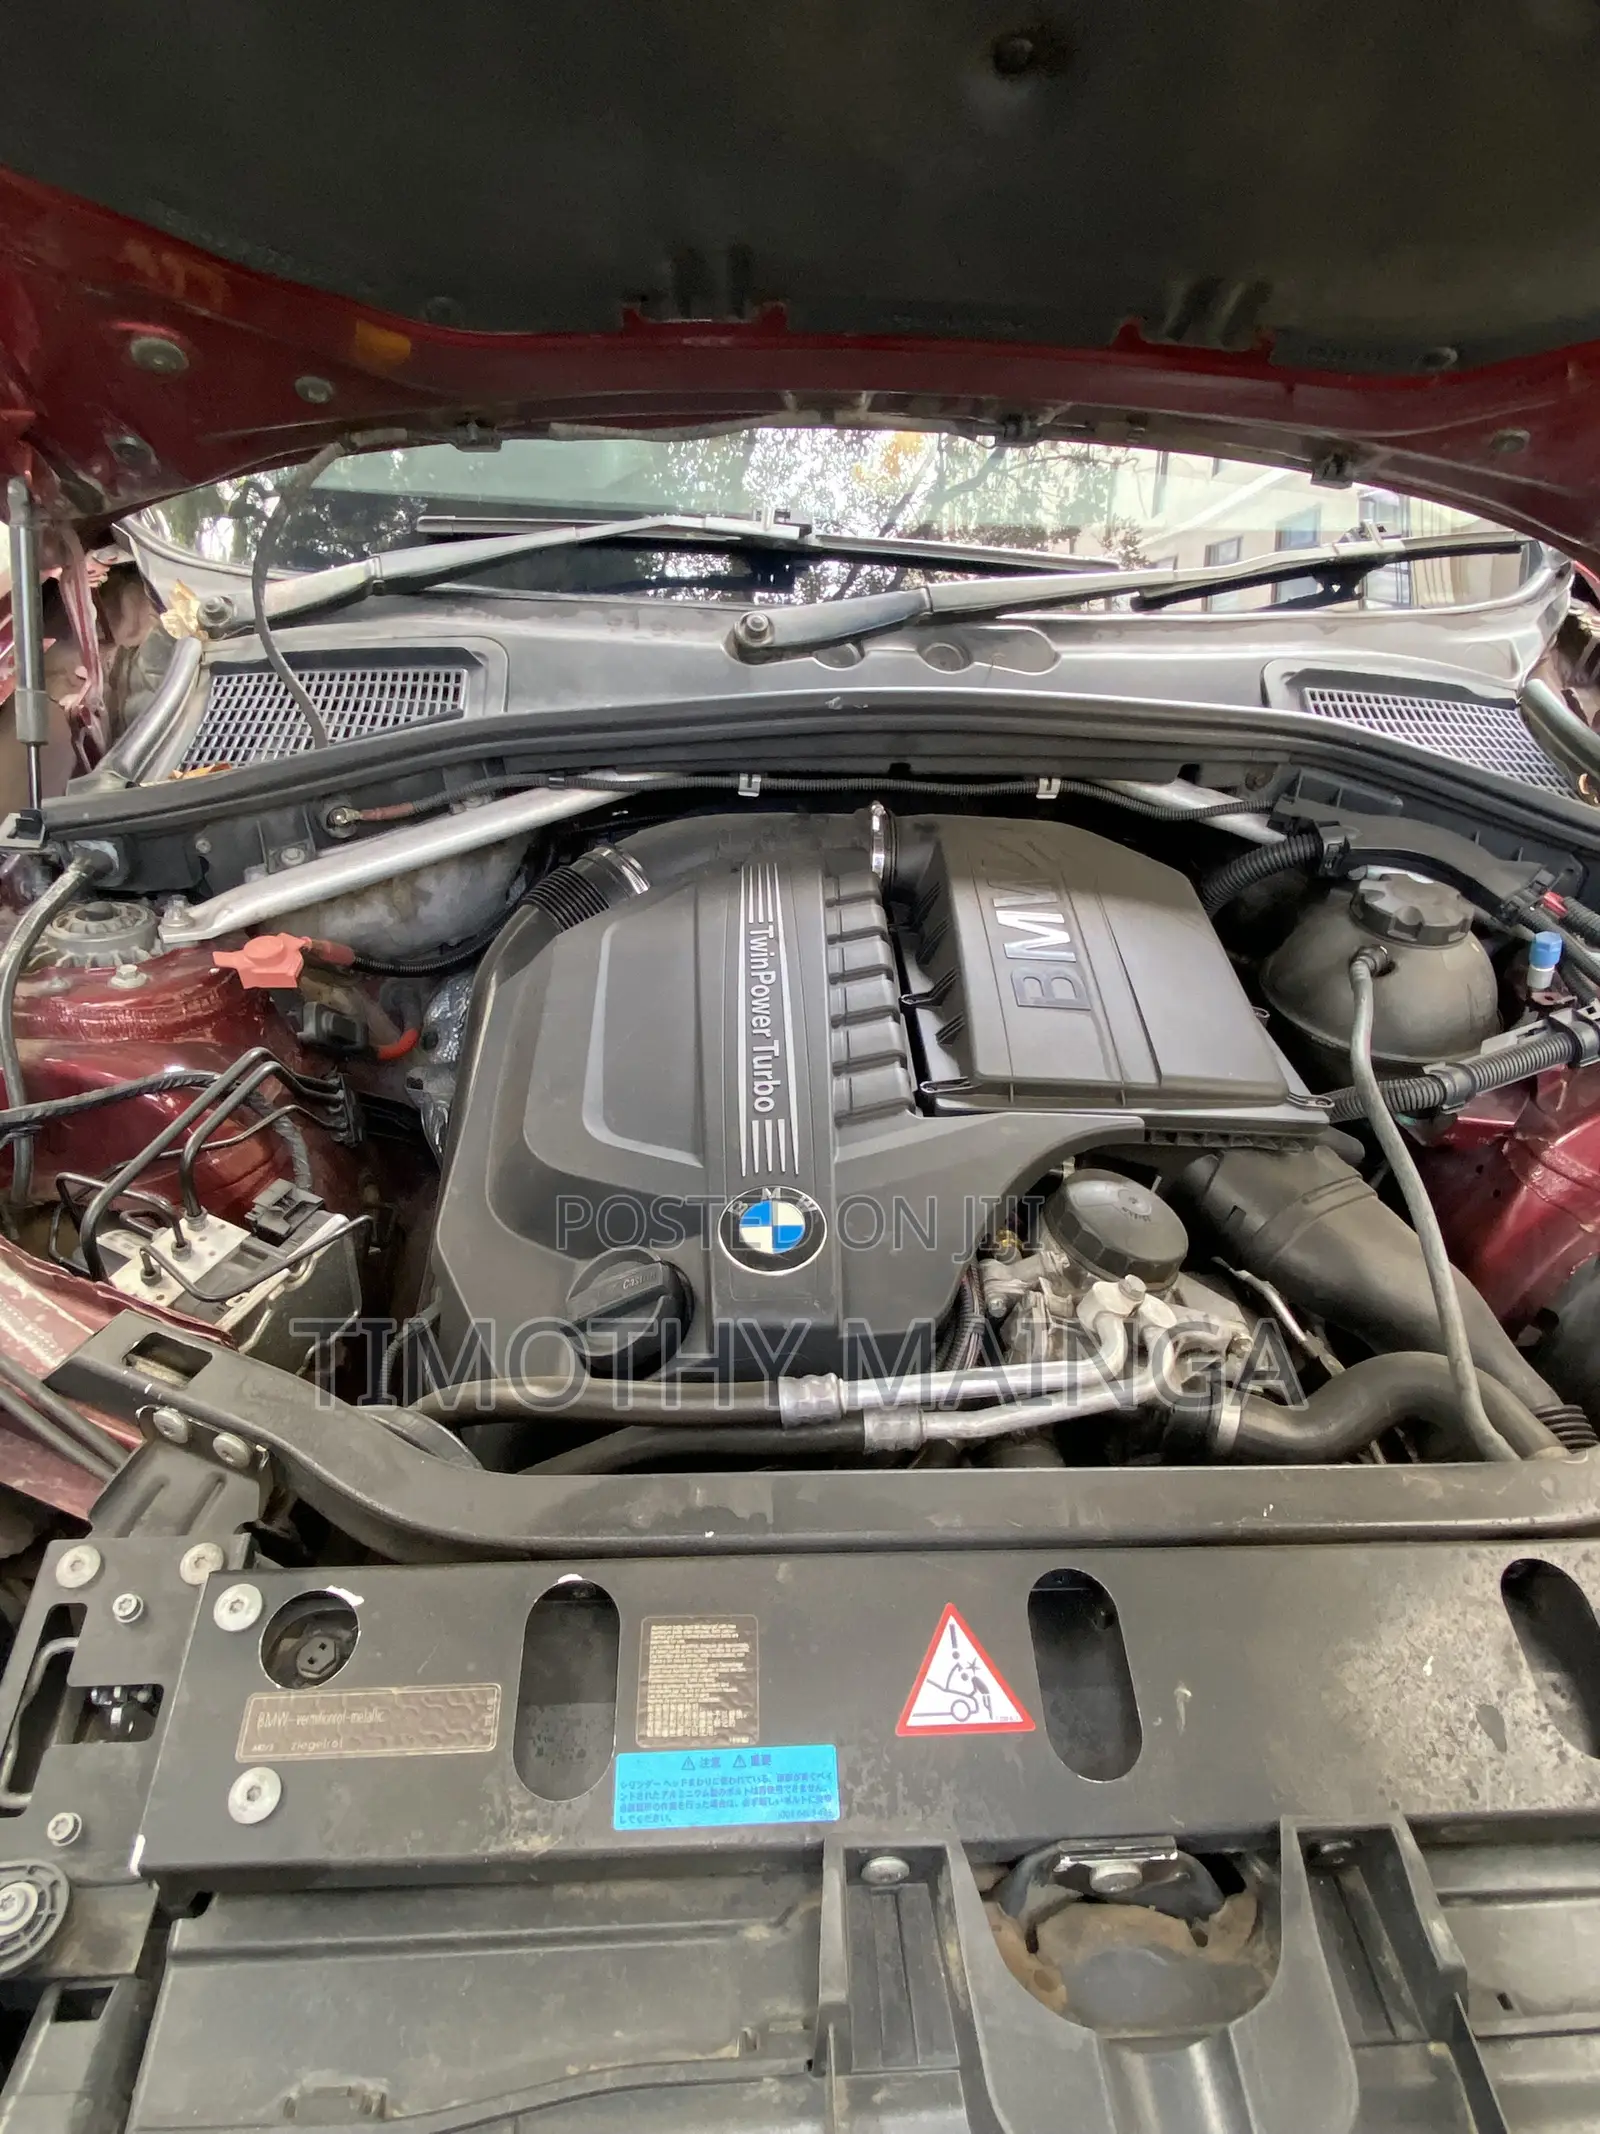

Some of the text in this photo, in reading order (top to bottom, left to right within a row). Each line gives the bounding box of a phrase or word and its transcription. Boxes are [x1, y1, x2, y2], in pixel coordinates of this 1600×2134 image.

[983, 842, 1092, 1011] BMW
[748, 924, 781, 1114] TwinPower Turbo
[727, 1187, 818, 1215] BMW
